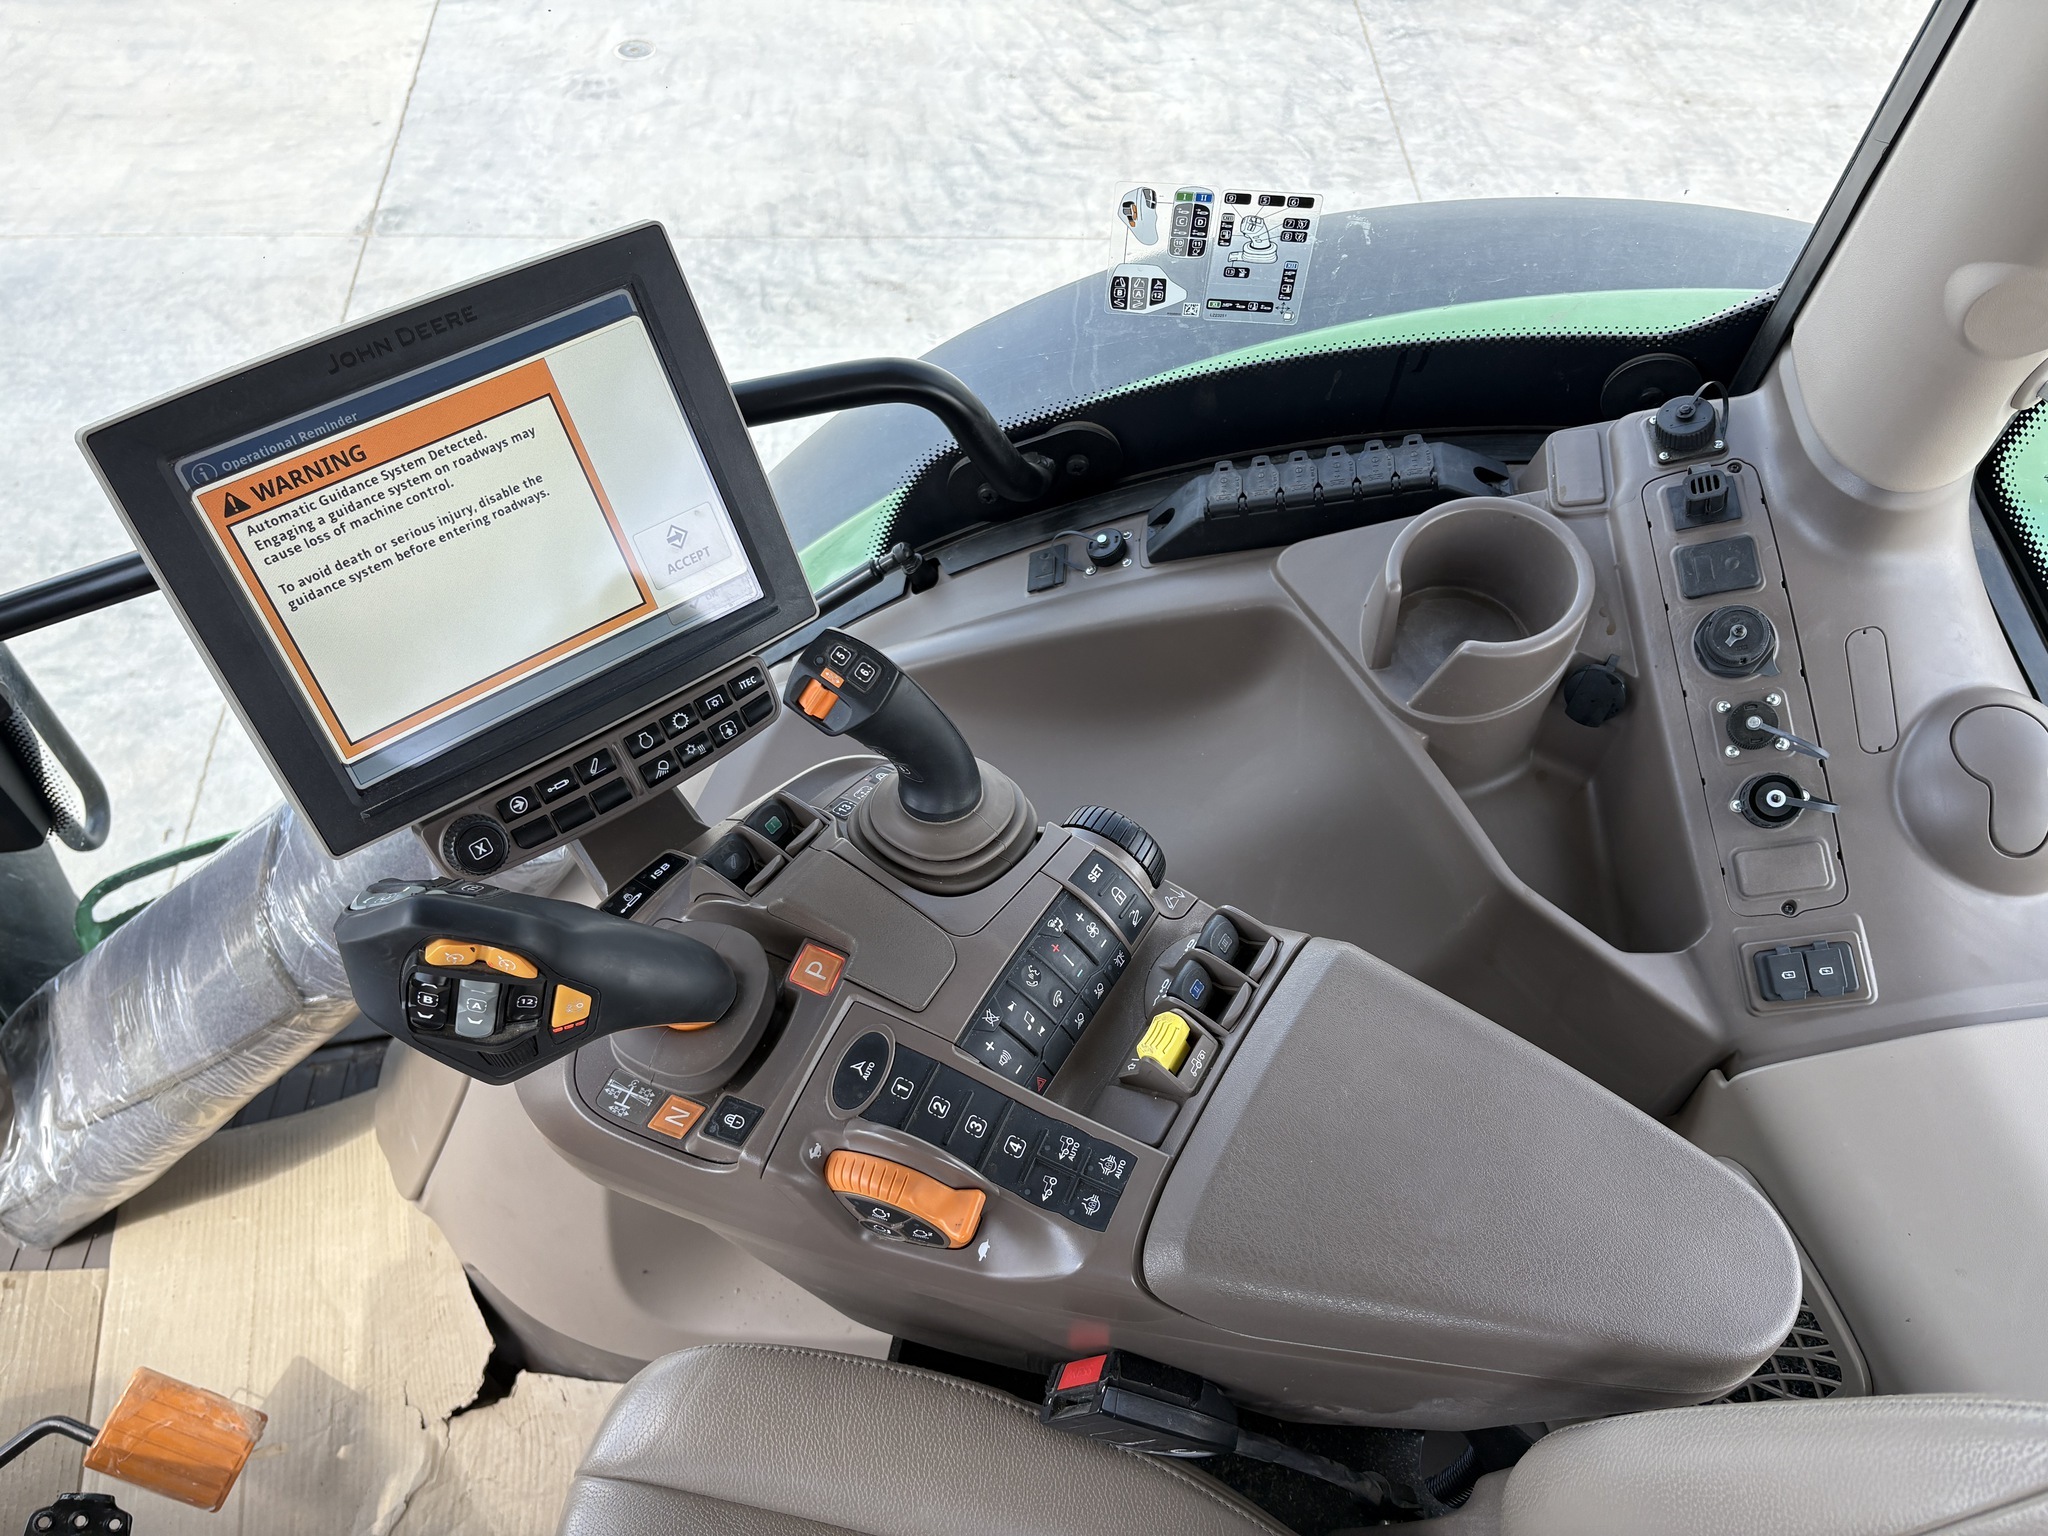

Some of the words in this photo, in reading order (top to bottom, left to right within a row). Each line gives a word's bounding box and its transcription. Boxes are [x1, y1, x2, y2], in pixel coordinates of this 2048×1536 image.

[328, 337, 393, 375] JOHN
[395, 306, 478, 347] DEERE
[222, 435, 297, 472] Operational
[298, 412, 358, 442] Reminder
[248, 501, 317, 536] Automatic
[319, 476, 379, 506] Guidance
[381, 456, 426, 481] System
[428, 430, 487, 461] Detected.
[250, 444, 367, 502] WARNING
[254, 520, 316, 551] Engaging
[318, 517, 326, 526] a
[328, 491, 385, 523] guidance
[388, 471, 432, 496] system
[434, 464, 450, 476] on
[453, 439, 509, 468] roadways
[511, 427, 536, 444] may
[264, 543, 302, 566] cause
[304, 532, 331, 548] loss
[333, 522, 347, 536] of
[350, 501, 403, 529] machine
[406, 479, 454, 505] control.
[278, 583, 295, 595] To
[298, 565, 332, 587] avoid
[334, 548, 372, 571] death
[375, 542, 387, 554] or
[391, 520, 436, 547] serious
[437, 504, 478, 526] injury,
[479, 484, 520, 509] disable
[523, 474, 543, 489] the
[289, 578, 346, 612] guidance
[349, 558, 393, 582] system
[395, 539, 436, 562] before
[439, 515, 491, 542] entering
[492, 489, 550, 519] roadways.
[667, 546, 710, 575] ACCEPT
[705, 590, 717, 600] OK
[836, 651, 845, 660] 5
[739, 674, 757, 690] iTEC
[839, 804, 851, 812] 13
[650, 863, 670, 880] ISB
[1088, 864, 1103, 883] SET
[805, 961, 826, 981] P
[863, 1061, 875, 1081] AUTO
[897, 1084, 908, 1092] 1
[664, 1106, 691, 1127] N
[933, 1101, 946, 1113] 2
[969, 1122, 982, 1132] 3
[1009, 1141, 1022, 1153] 4
[1068, 1142, 1080, 1162] AUTO
[1114, 1159, 1126, 1179] AUTO
